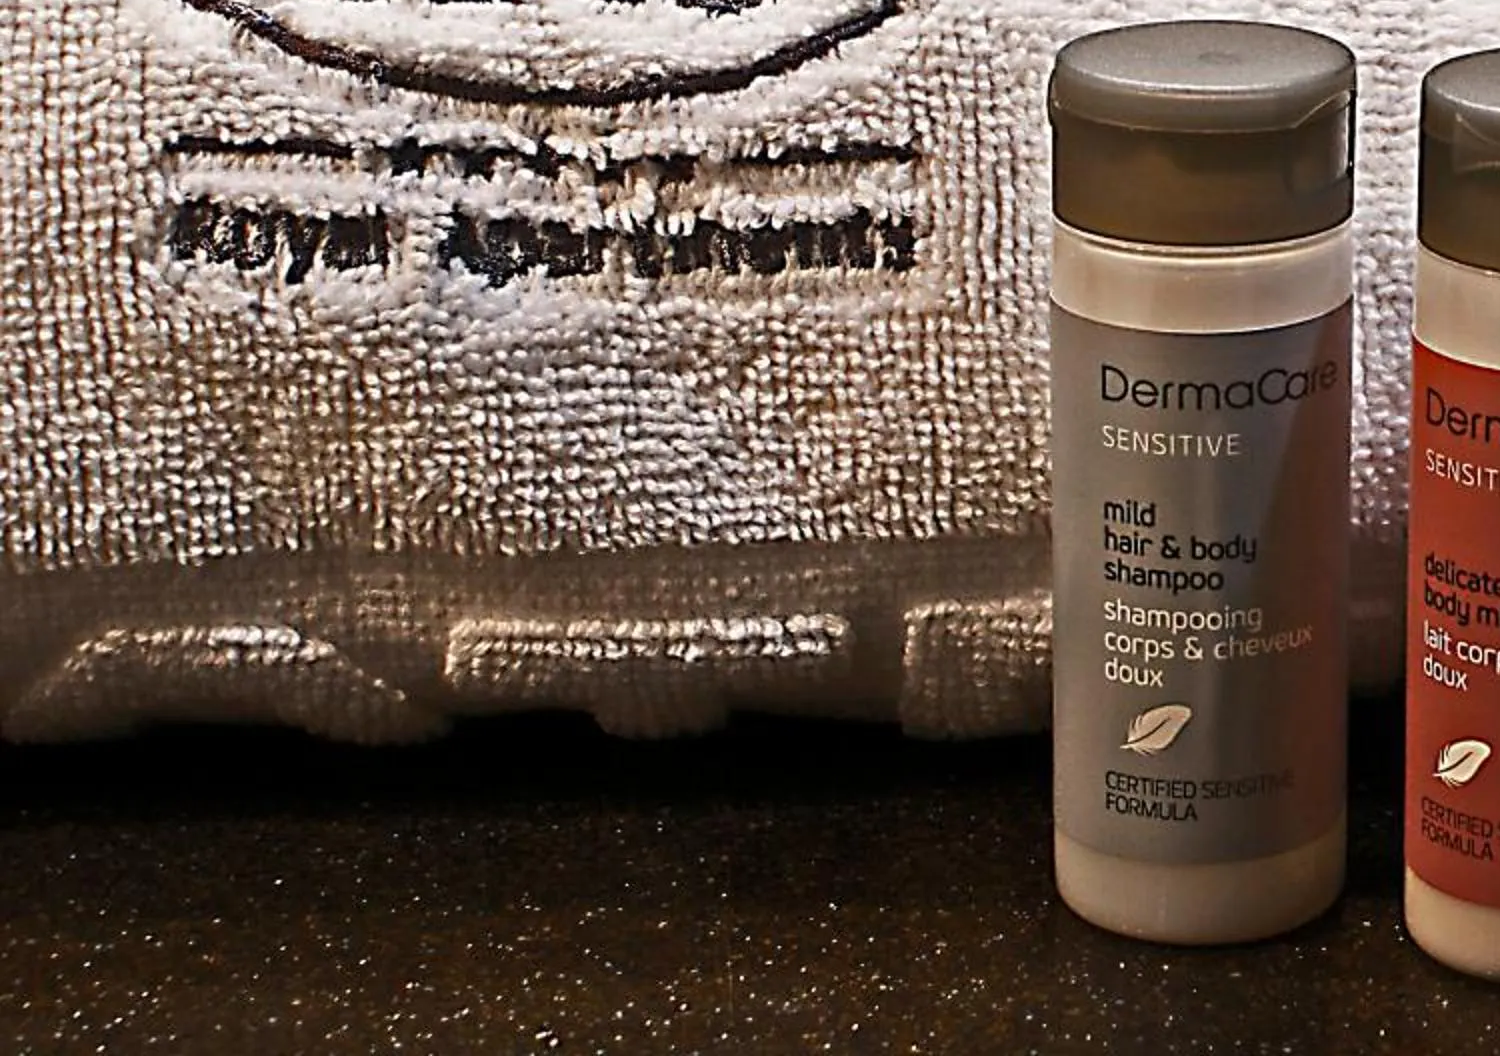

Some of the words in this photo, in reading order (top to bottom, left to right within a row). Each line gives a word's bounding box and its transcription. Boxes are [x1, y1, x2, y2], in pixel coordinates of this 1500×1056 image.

[1101, 360, 1338, 411] DermaCare
[1102, 425, 1241, 457] SENSITIVE
[1104, 499, 1156, 528] mild
[1104, 527, 1152, 557] hair
[1161, 536, 1181, 560] &
[1191, 535, 1257, 563] body
[1104, 560, 1224, 595] shampoo
[1104, 598, 1263, 634] shampooing
[1425, 580, 1470, 626] body
[1104, 632, 1174, 665] corps
[1185, 639, 1204, 661] &
[1214, 624, 1313, 660] cheveux
[1424, 620, 1451, 656] lait
[1105, 659, 1164, 687] doux
[1423, 654, 1468, 691] doux
[1106, 771, 1196, 799] CERTIFIED
[1106, 793, 1198, 821] FORMULA
[1421, 797, 1493, 839] CERTIFIED
[1421, 818, 1494, 860] FORMULA
